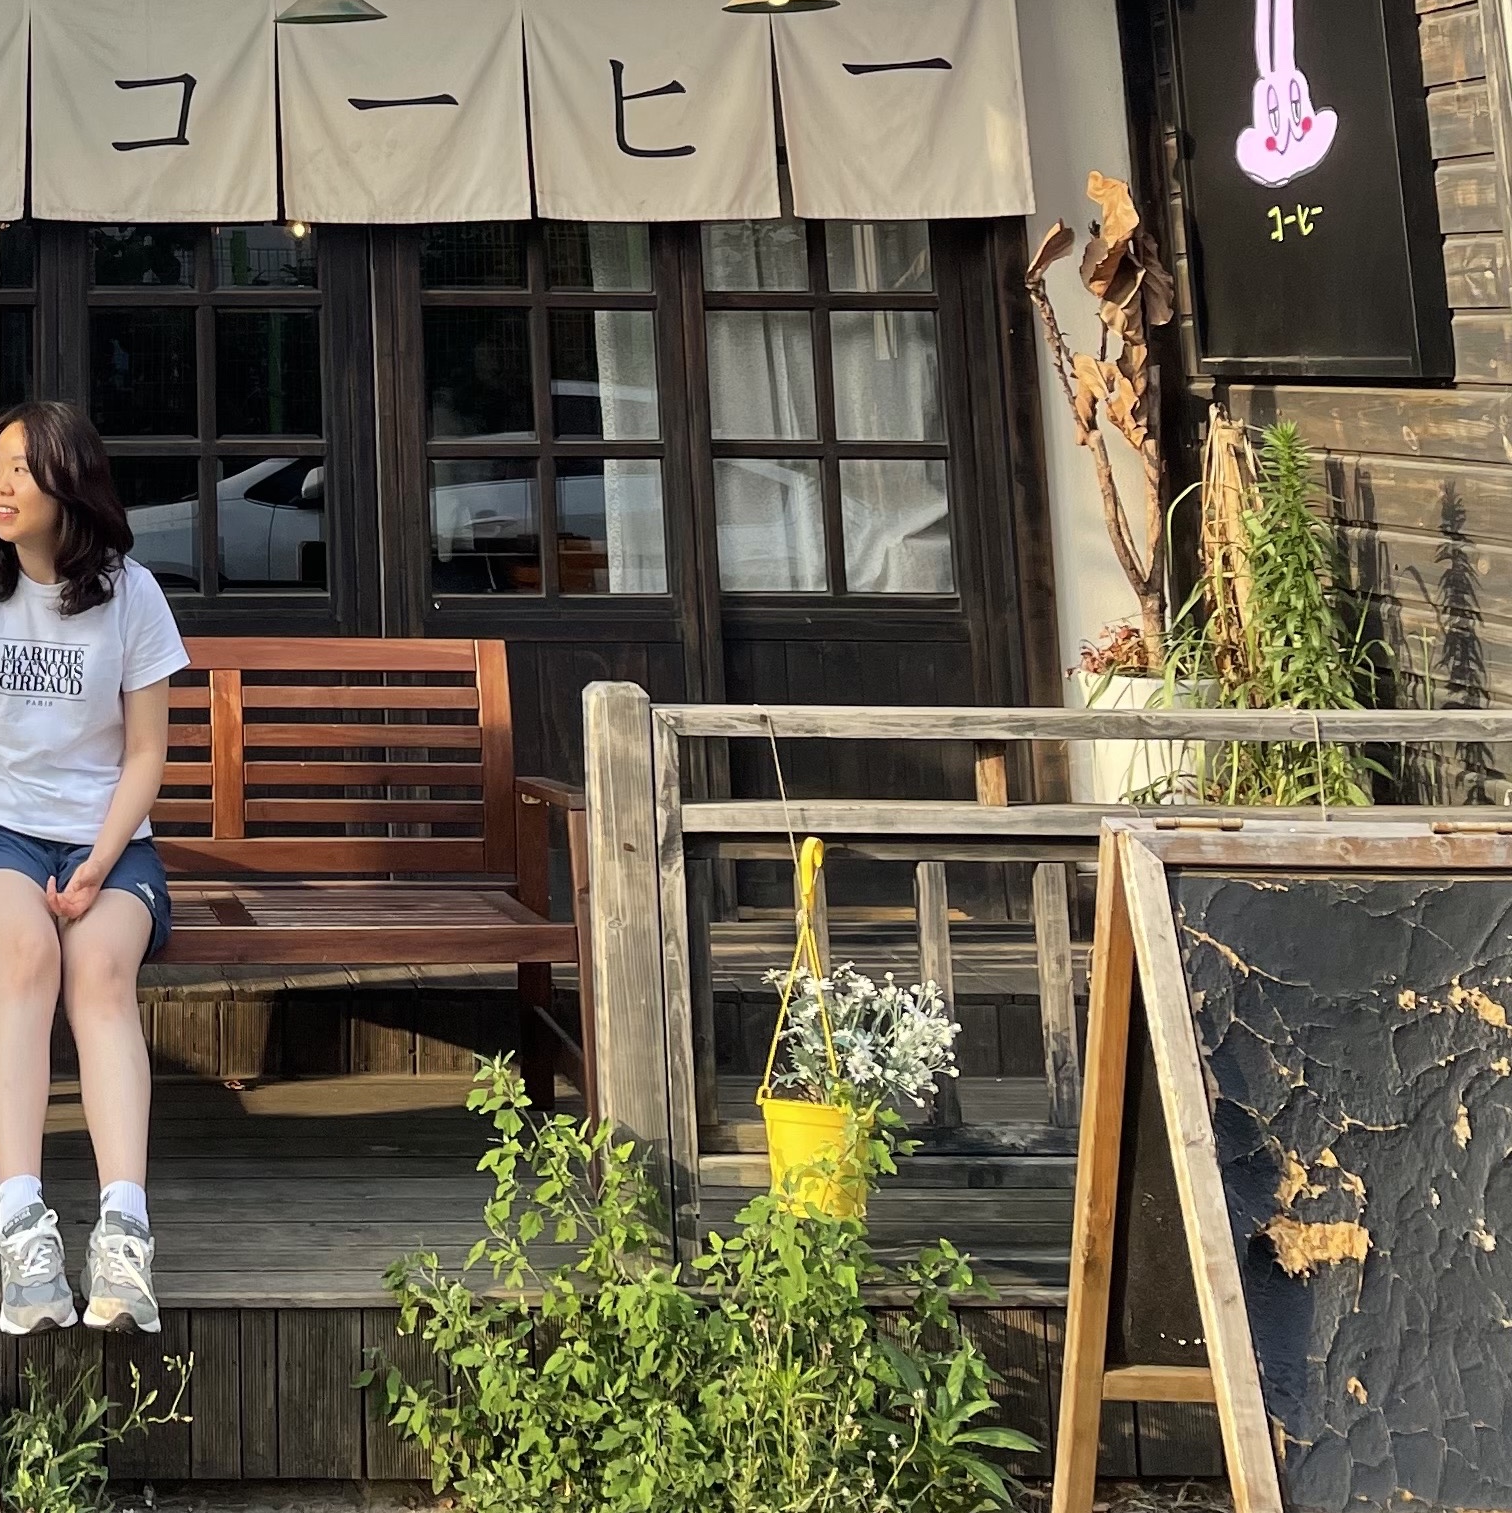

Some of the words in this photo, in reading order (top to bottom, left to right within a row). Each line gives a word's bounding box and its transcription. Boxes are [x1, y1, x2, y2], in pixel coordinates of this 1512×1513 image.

[111, 57, 953, 158] コーヒー
[1267, 203, 1324, 242] コーヒー
[1, 644, 85, 665] MARITHÉ
